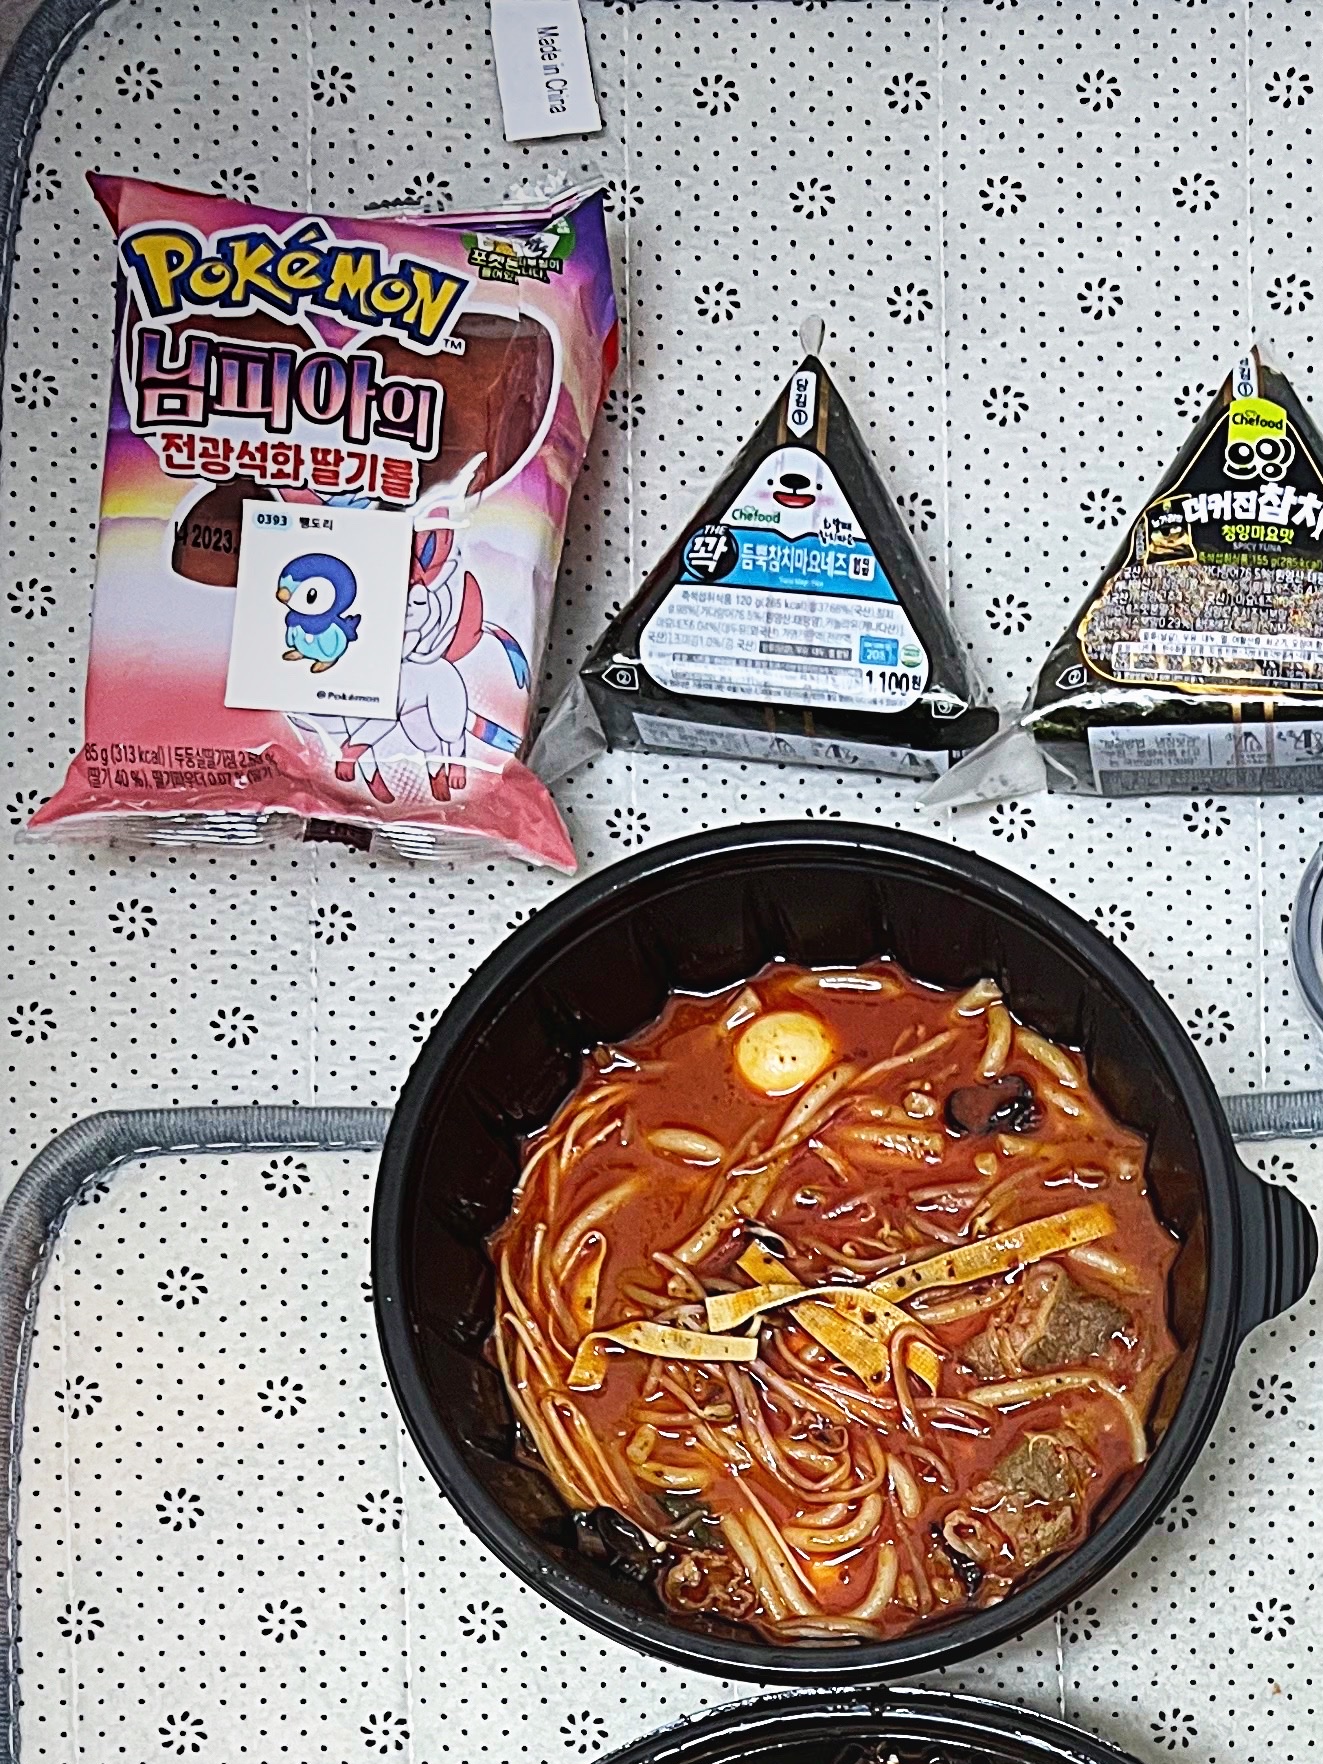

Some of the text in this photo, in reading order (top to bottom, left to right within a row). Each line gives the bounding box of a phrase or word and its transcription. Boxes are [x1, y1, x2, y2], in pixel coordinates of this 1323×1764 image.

[536, 26, 562, 61] Made
[543, 62, 565, 76] in
[136, 329, 443, 449] 님피아의
[1232, 412, 1284, 430] Chefood
[160, 432, 414, 499] 전광석화 딸기롤
[256, 513, 288, 526] 0393
[731, 508, 781, 524] Chefood
[704, 525, 728, 535] THE
[1221, 524, 1294, 545] 청양마요맛
[688, 536, 728, 572] 꽉
